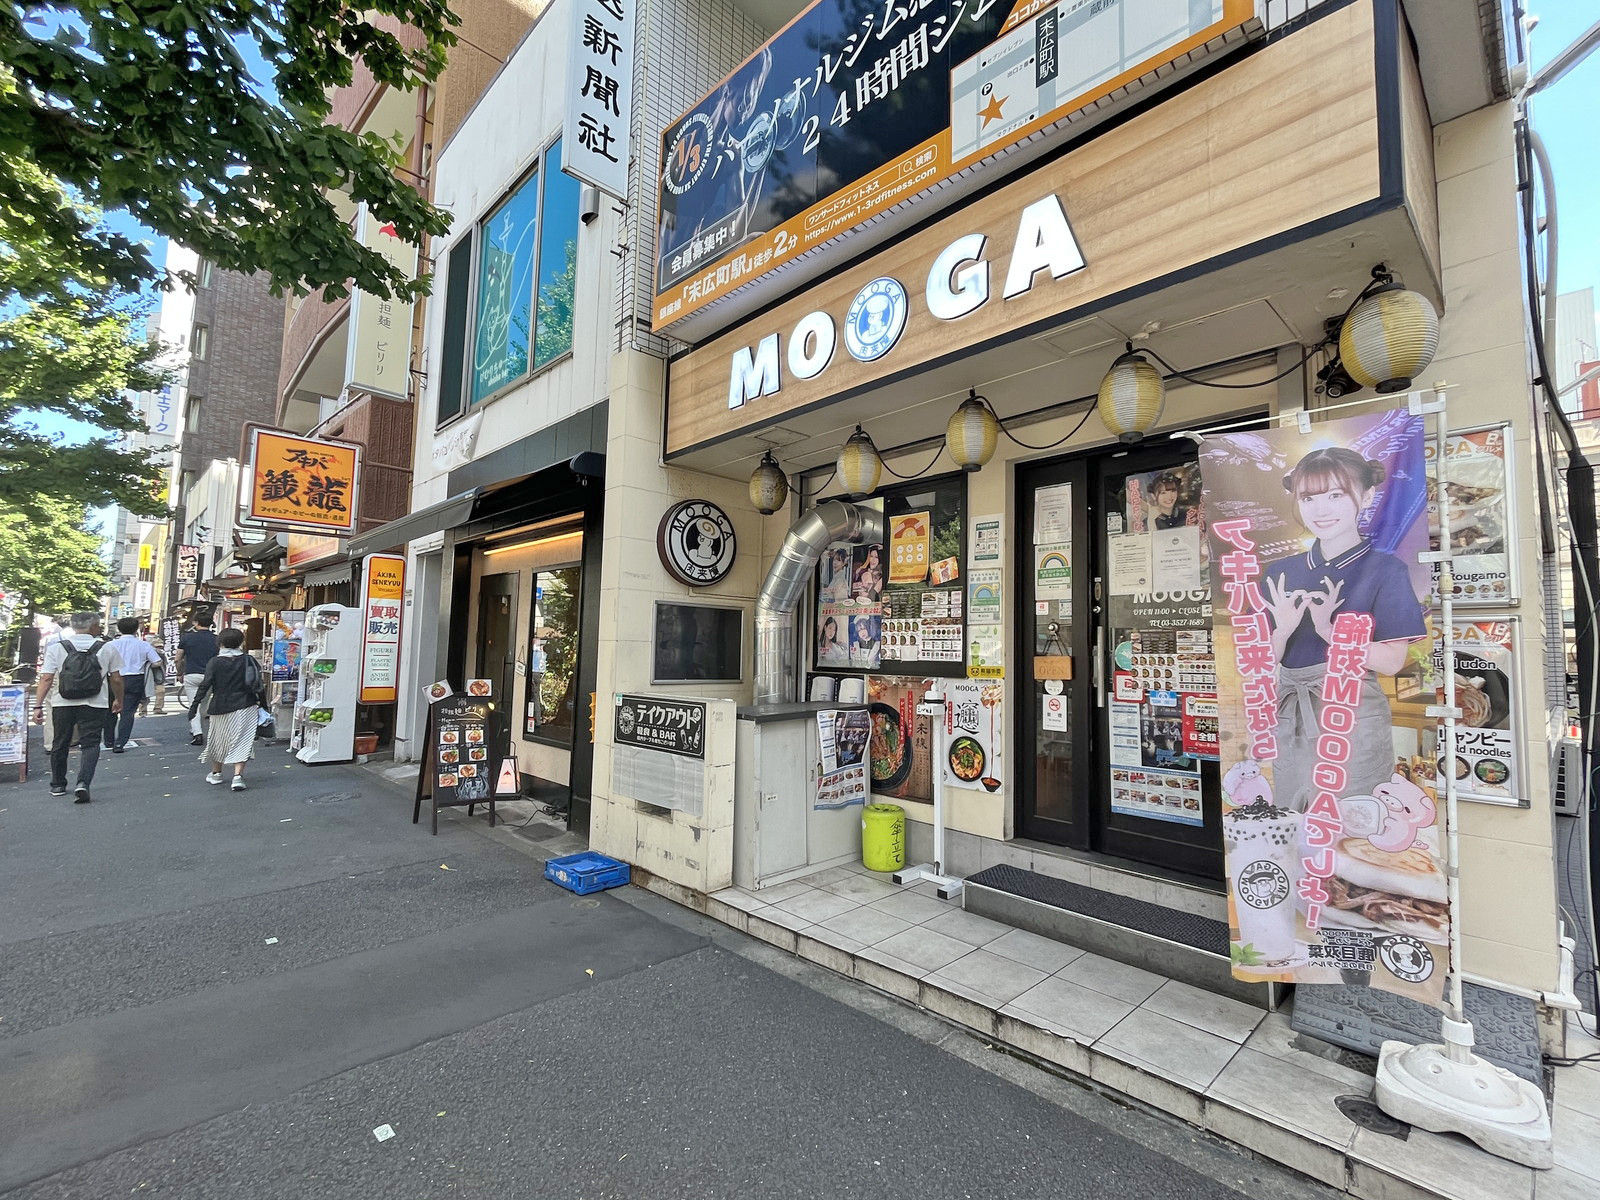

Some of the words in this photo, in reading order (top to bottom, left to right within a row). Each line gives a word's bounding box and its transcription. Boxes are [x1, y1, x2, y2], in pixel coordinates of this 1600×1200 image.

[1039, 17, 1054, 79] 末広町駅
[804, 166, 937, 243] https://www.1-3rdfitness.com
[808, 180, 880, 225] ワンサードフィットネス
[671, 219, 737, 275] 会員募集中!
[847, 281, 901, 326] MOOGA
[282, 448, 329, 470] アキバ
[673, 504, 735, 543] MOOGA
[371, 578, 401, 587] SENRYUU
[377, 571, 396, 579] AKIBA
[370, 605, 399, 619] 買取
[1133, 608, 1154, 616] OPEN
[1178, 606, 1201, 616] CLOSE
[368, 620, 397, 635] 販売
[1039, 665, 1065, 675] OPEN
[1460, 658, 1497, 670] udon
[636, 704, 697, 730] テイクアウト
[660, 730, 676, 740] BAR
[1469, 746, 1512, 758] noodles
